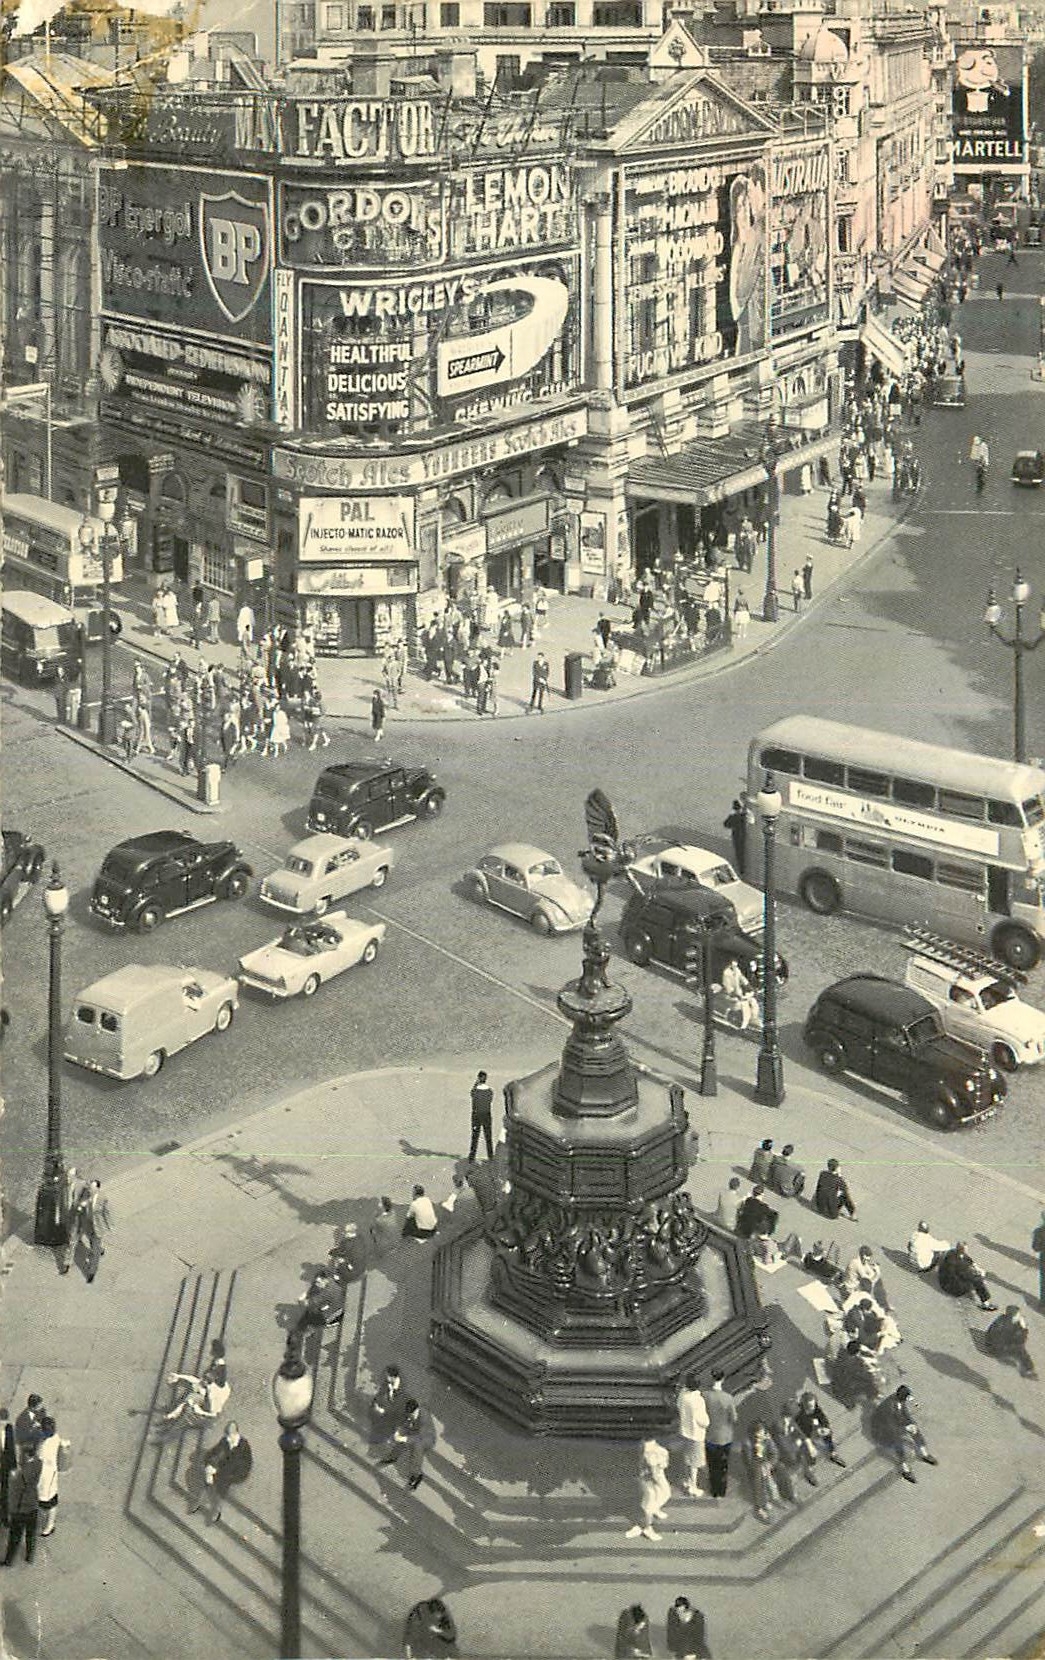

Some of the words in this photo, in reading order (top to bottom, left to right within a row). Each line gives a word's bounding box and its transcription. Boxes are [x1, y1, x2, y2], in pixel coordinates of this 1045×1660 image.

[297, 101, 435, 159] FACTOR
[948, 140, 1022, 157] MARTELL
[465, 165, 571, 214] LEMON
[209, 217, 261, 285] BP
[339, 275, 475, 317] WRIGLEY'S
[331, 343, 413, 364] HEALTHFUL
[450, 352, 498, 378] SPEARMINT
[328, 373, 407, 392] DELICIOUS
[326, 400, 409, 422] SATISFYING
[340, 501, 376, 522] PAL
[376, 527, 404, 539] RAZOR
